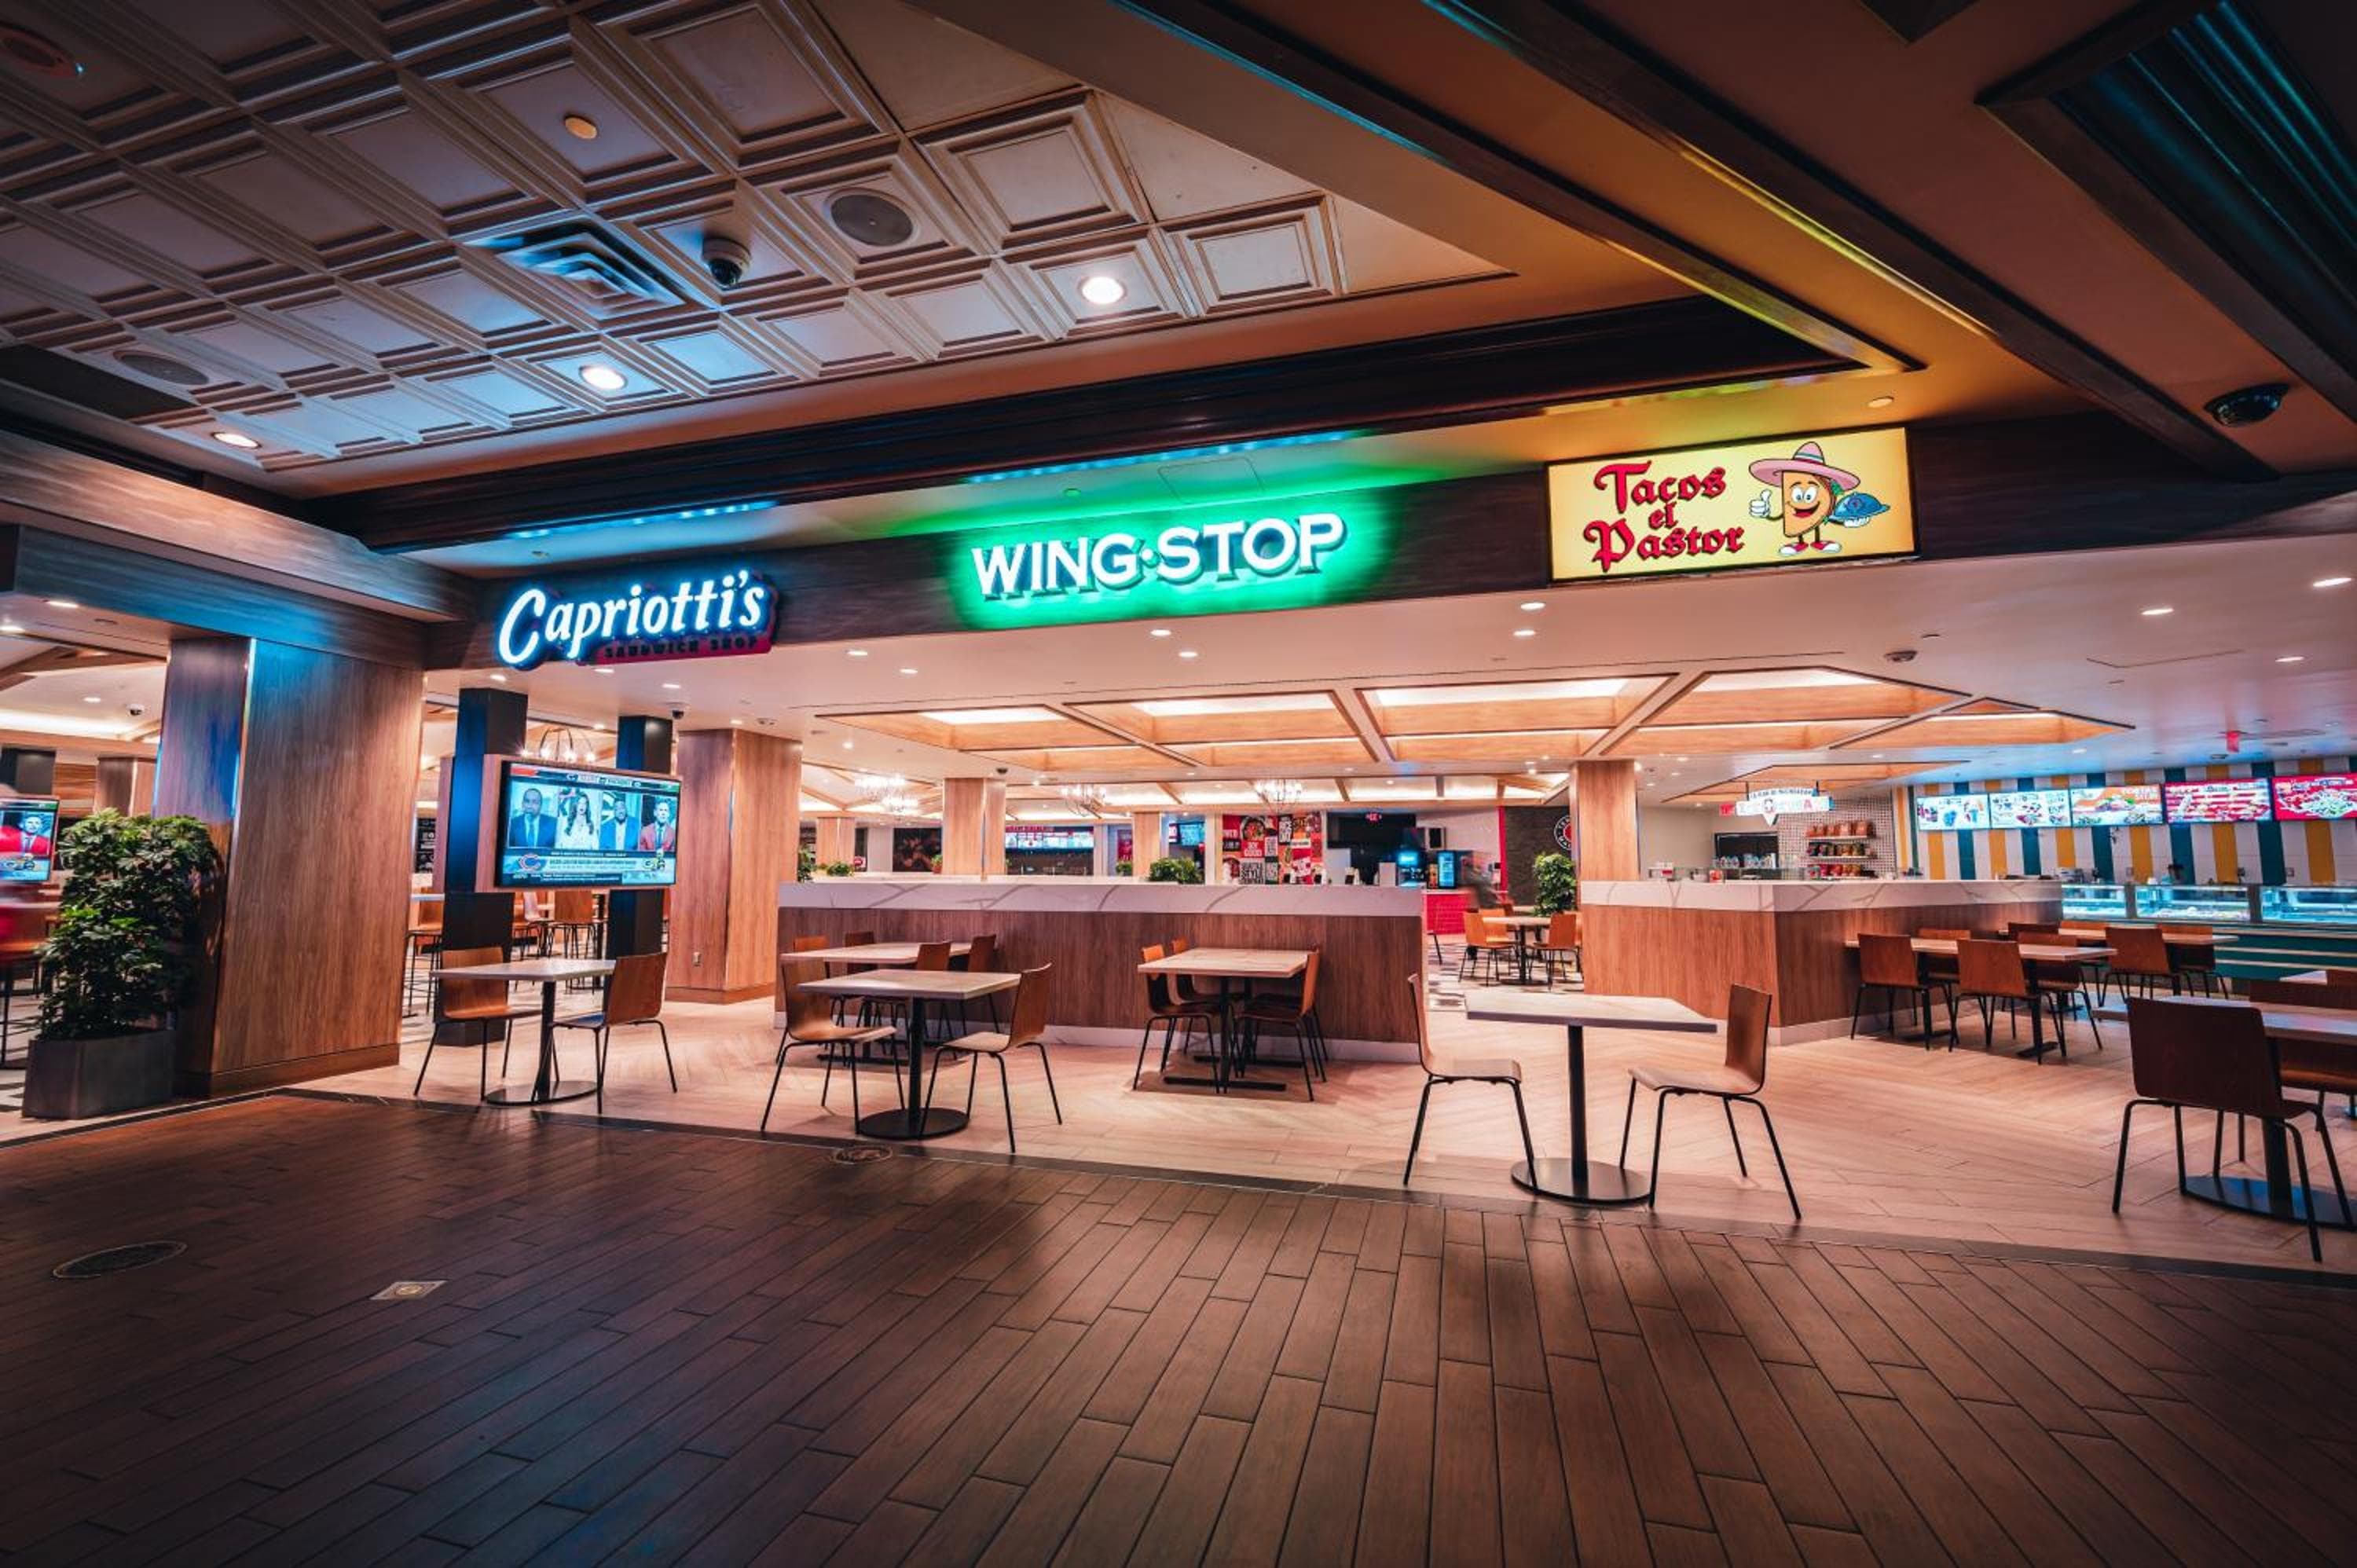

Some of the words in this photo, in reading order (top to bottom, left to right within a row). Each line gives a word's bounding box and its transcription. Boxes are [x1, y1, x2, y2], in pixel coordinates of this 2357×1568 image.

[1593, 460, 1727, 515] Tacos
[1648, 500, 1679, 530] el
[1583, 518, 1745, 573] Pastor
[498, 570, 765, 664] Capriotti's
[604, 639, 699, 658] SANDWICH
[709, 637, 758, 650] SHOP
